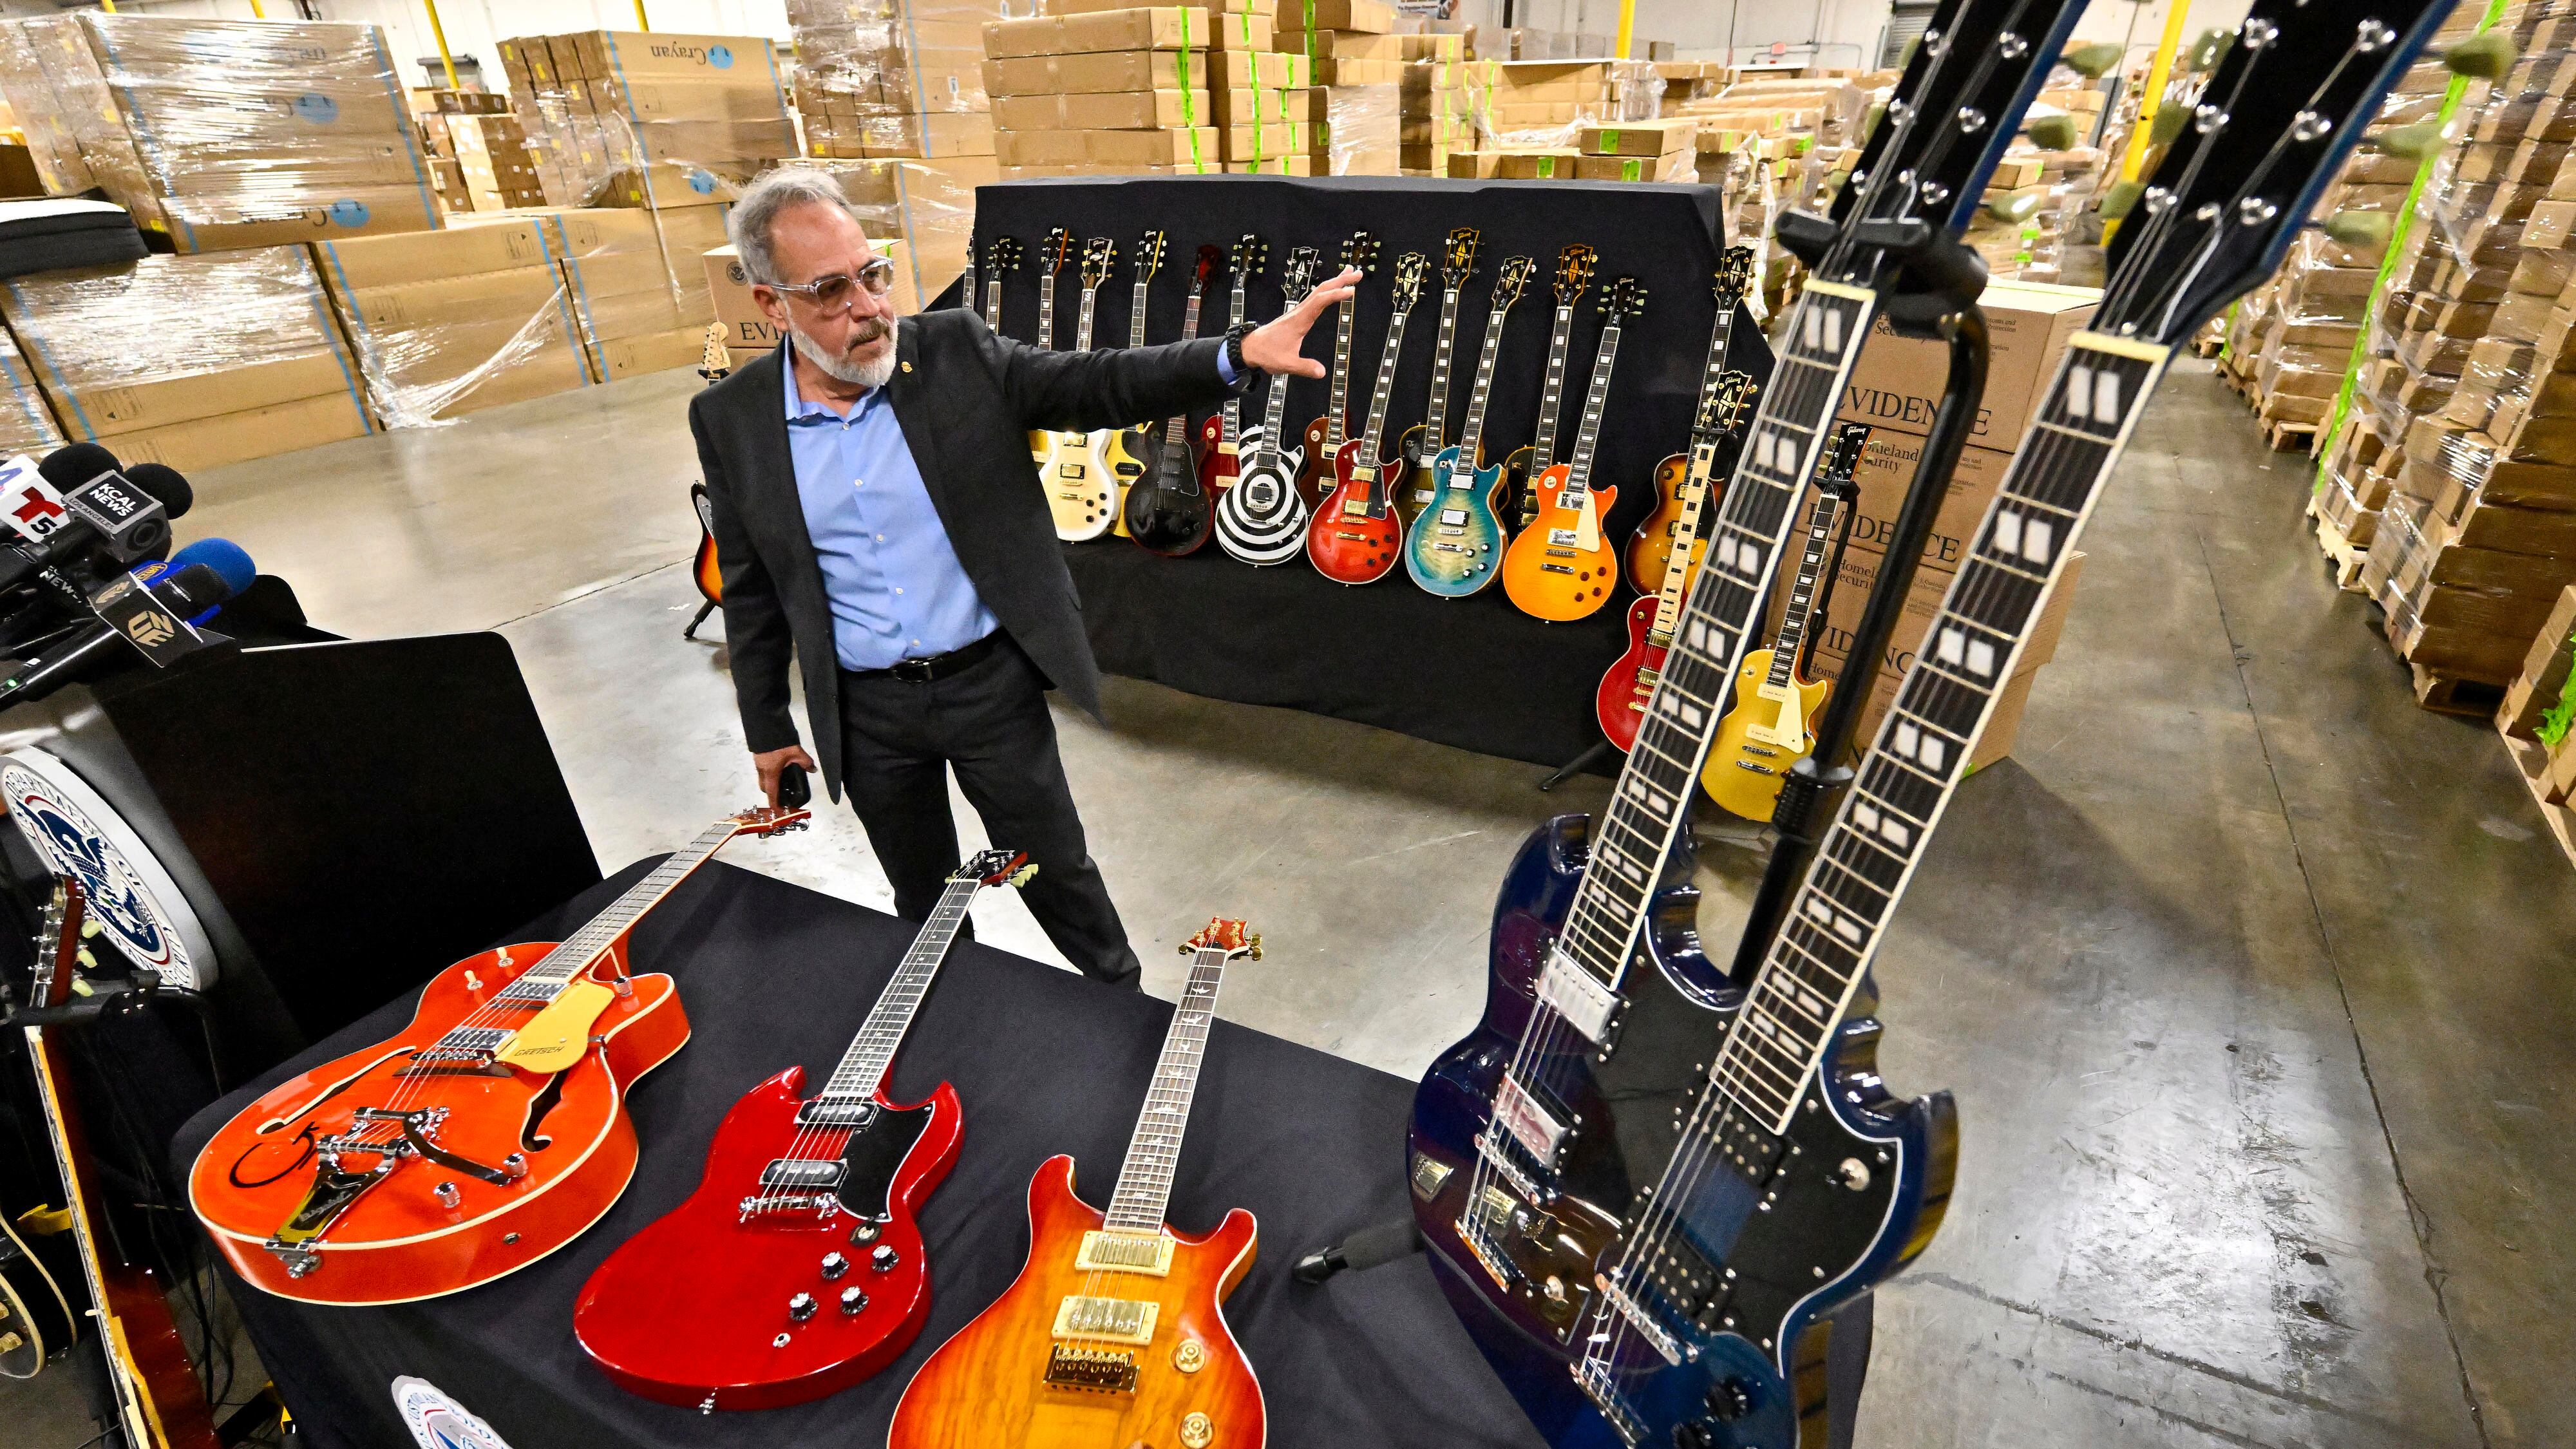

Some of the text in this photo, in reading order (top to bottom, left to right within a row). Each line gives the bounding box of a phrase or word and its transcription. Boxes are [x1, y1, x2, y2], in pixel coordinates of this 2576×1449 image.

[1835, 386, 1991, 436] VIDENE
[89, 489, 131, 516] NEWS
[99, 483, 137, 512] KCAL
[68, 498, 115, 529] LOS ANGELES
[515, 1045, 565, 1057] GRETSCH
